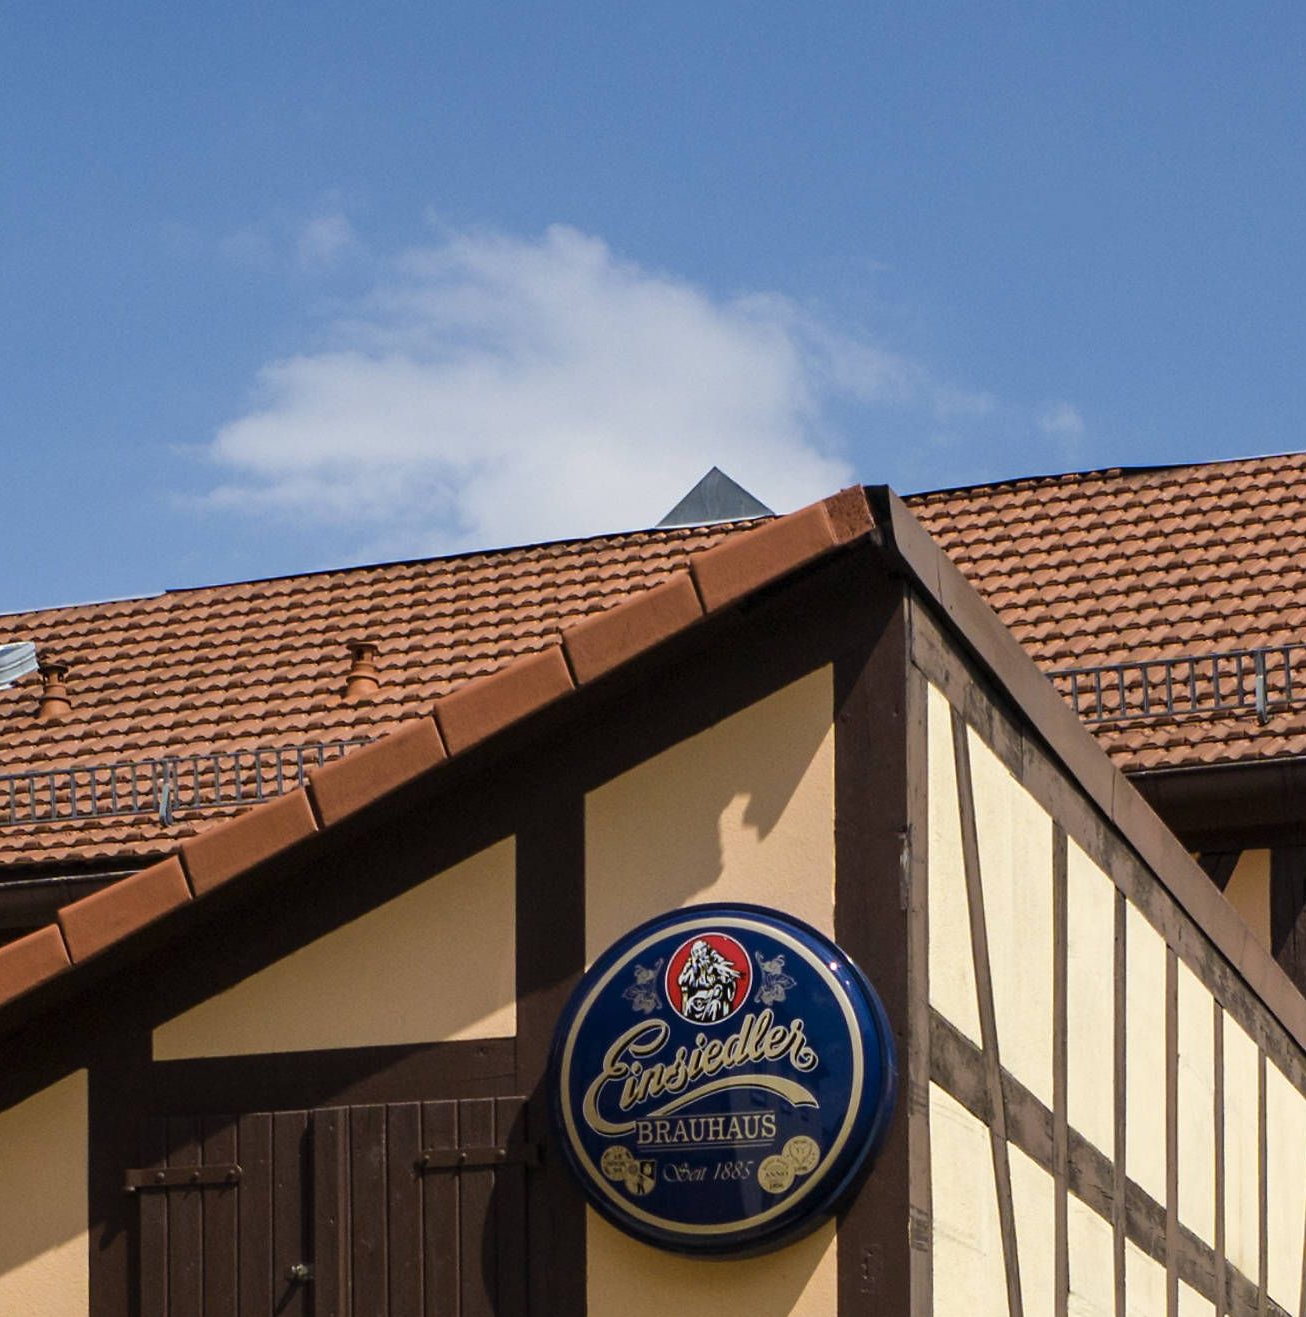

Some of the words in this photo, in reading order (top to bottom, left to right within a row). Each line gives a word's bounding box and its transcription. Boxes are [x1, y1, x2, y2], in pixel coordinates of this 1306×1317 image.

[583, 1008, 819, 1137] Einsiedler
[636, 1113, 777, 1144] BRAUHAUS
[713, 1160, 755, 1182] 1885
